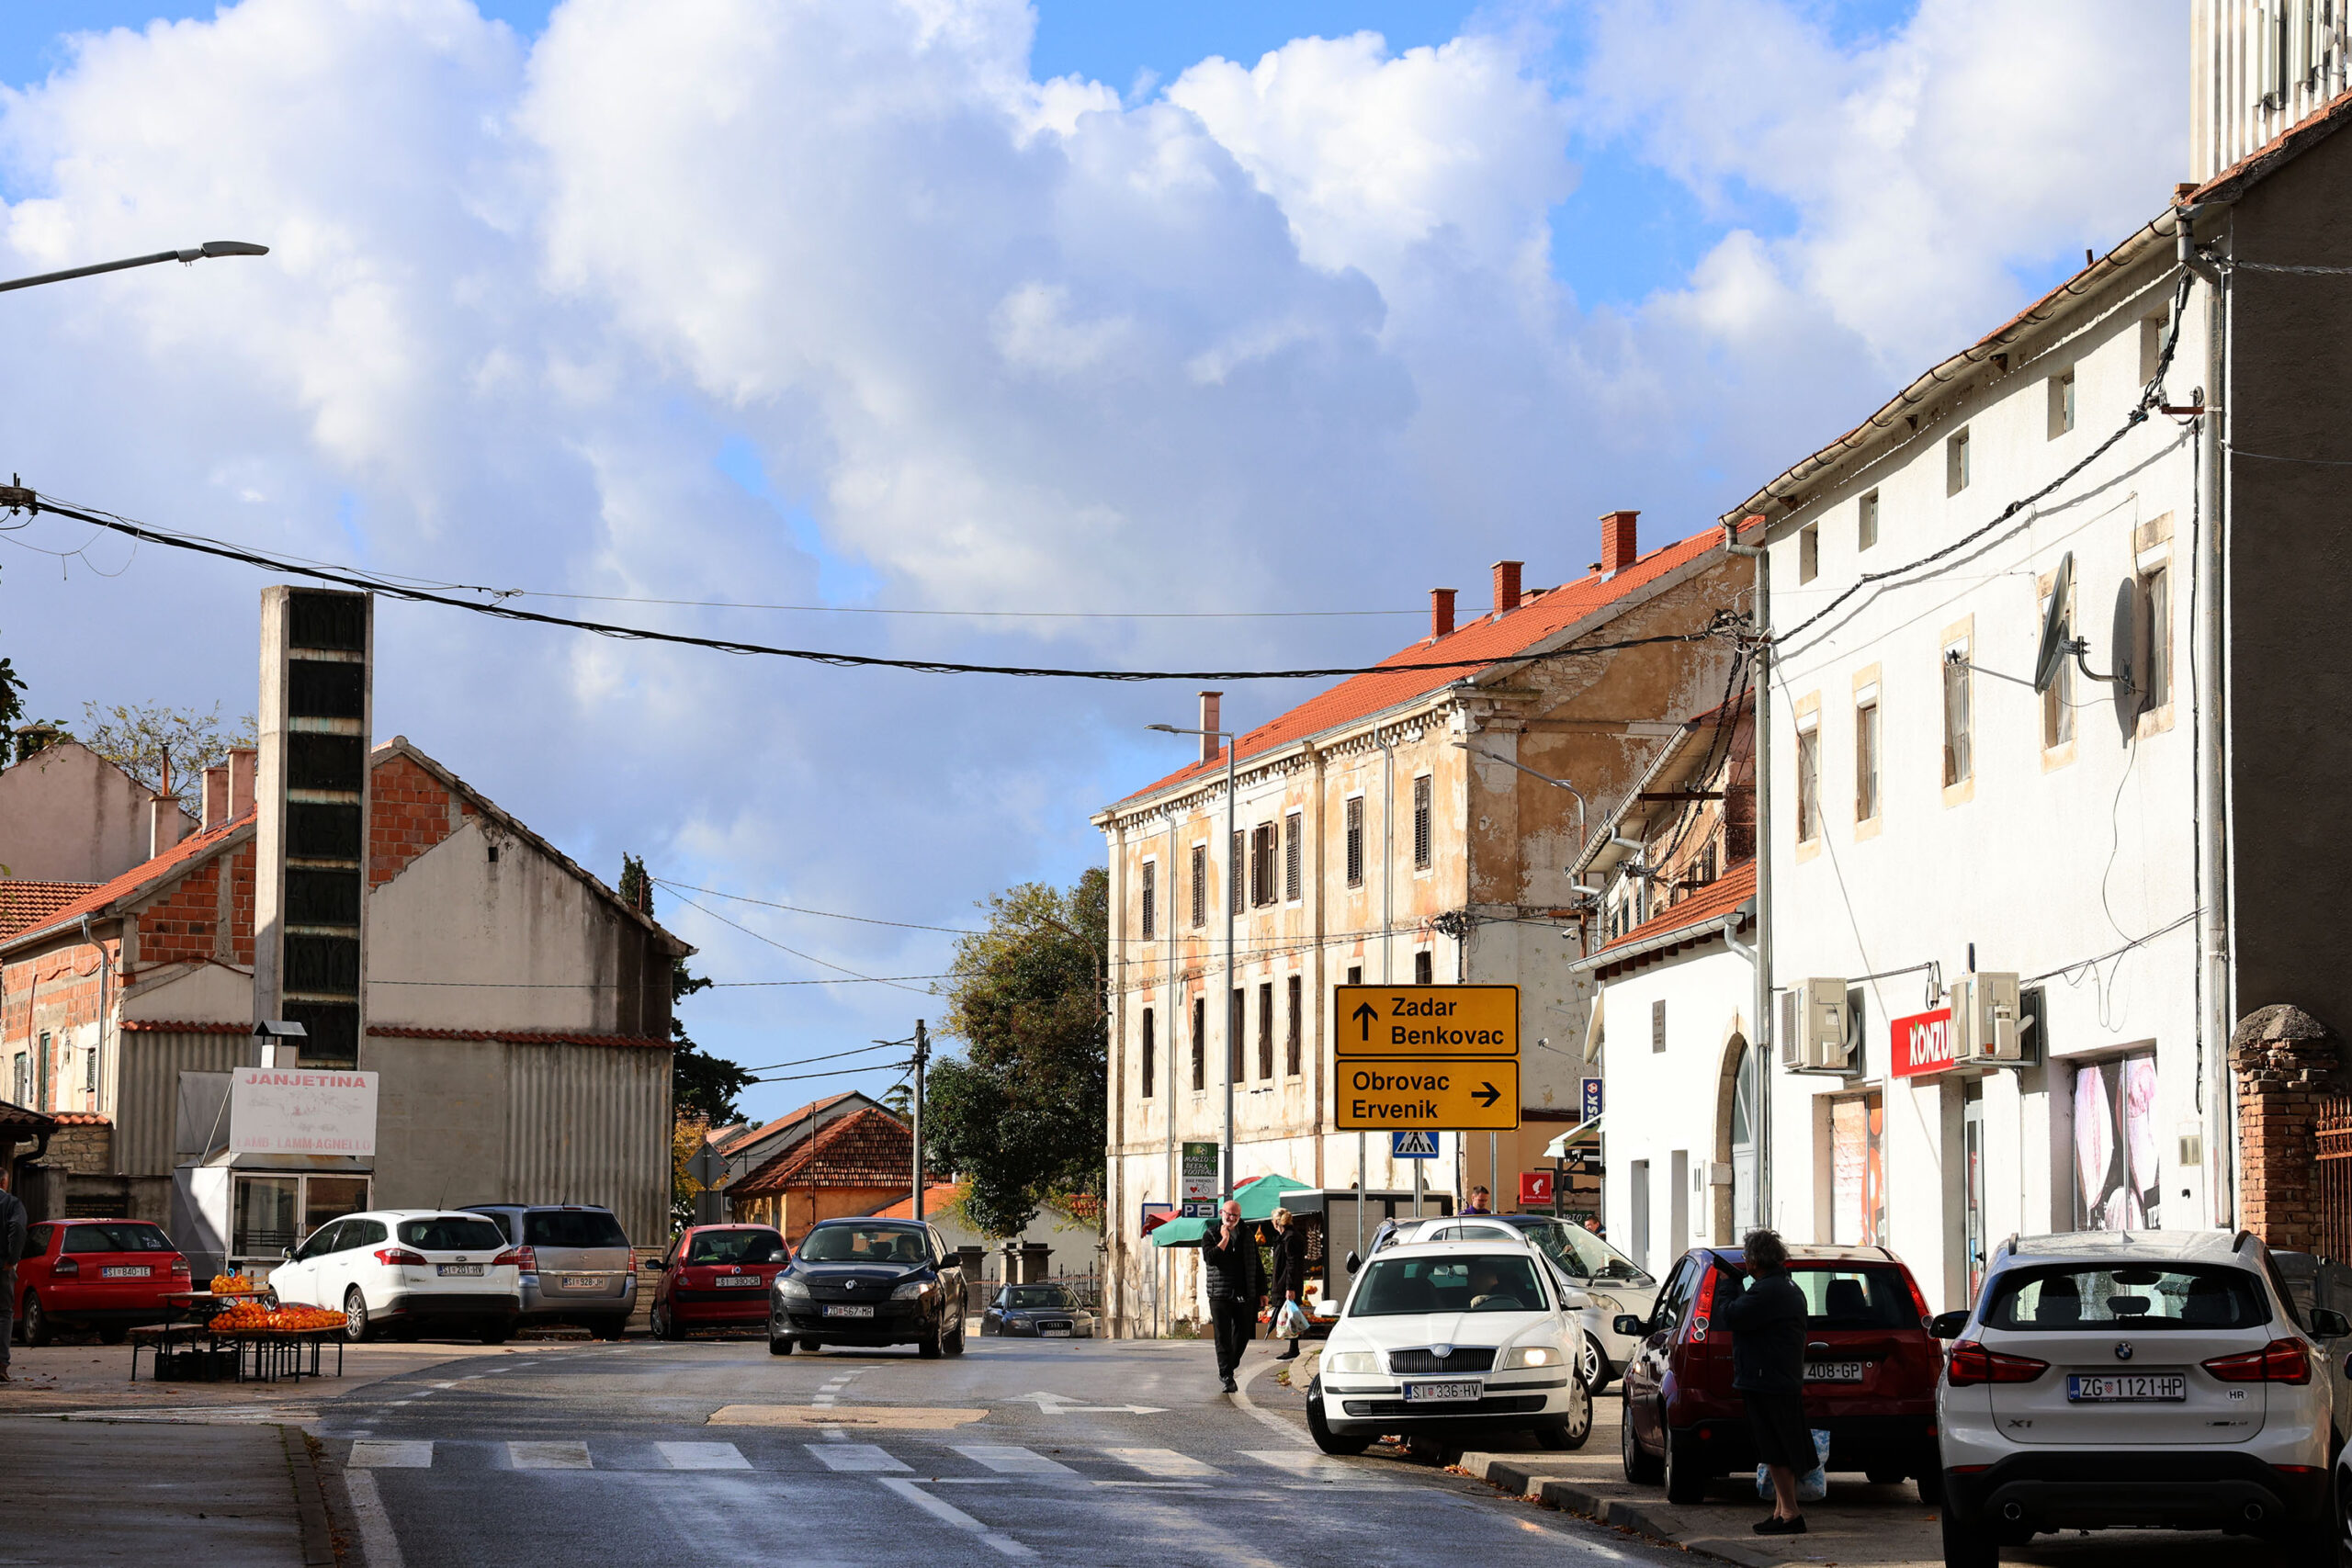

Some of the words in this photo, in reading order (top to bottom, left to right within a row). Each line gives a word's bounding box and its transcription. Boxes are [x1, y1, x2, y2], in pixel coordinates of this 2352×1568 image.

[1391, 997, 1457, 1017] Zadar
[1391, 1026, 1504, 1045] Benkovac
[245, 1073, 367, 1089] JANJETINA
[1352, 1071, 1450, 1091] Obrovac
[1352, 1100, 1439, 1119] Ervenik
[1184, 1204, 1194, 1217] P
[443, 1266, 451, 1274] SI
[1807, 1363, 1860, 1379] 408-GP
[1412, 1386, 1426, 1399] SI
[2081, 1379, 2102, 1396] ZG
[2116, 1378, 2183, 1396] 1121-HP
[2229, 1391, 2245, 1400] HR
